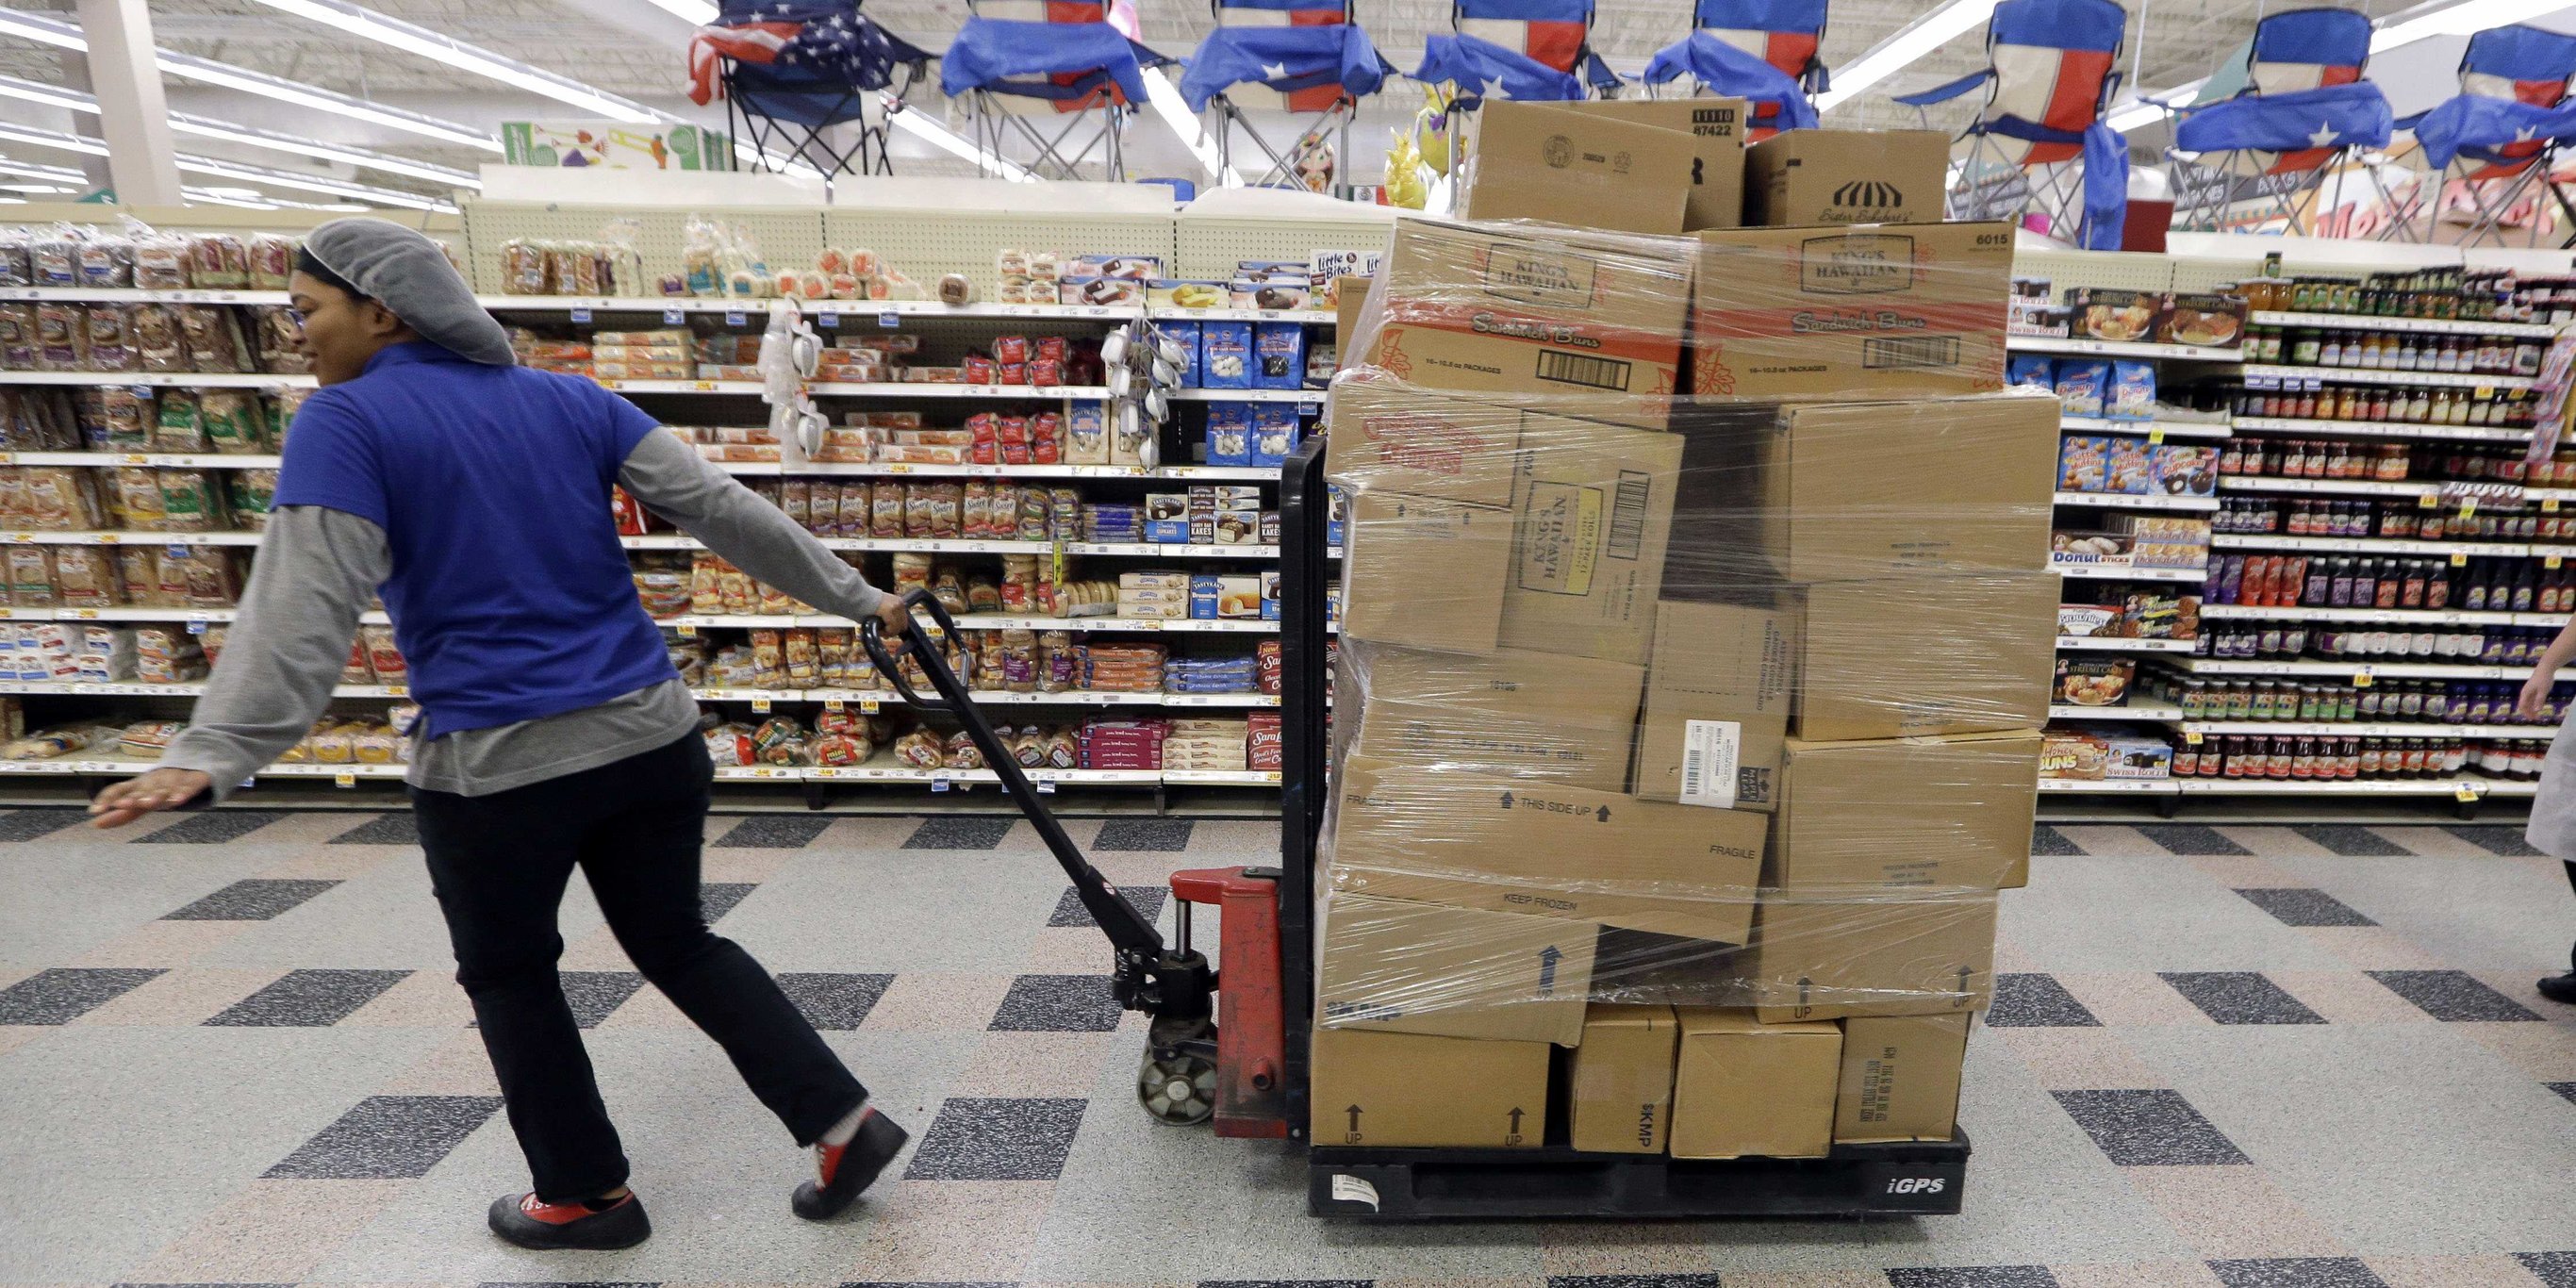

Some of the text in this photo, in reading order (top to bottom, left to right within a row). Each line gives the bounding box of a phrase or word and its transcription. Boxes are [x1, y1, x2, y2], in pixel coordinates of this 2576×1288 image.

[1976, 235, 2007, 244] 6015
[1318, 253, 1343, 272] Little
[1831, 251, 1886, 262] KING'S
[1326, 264, 1352, 280] Bites
[1515, 260, 1569, 278] KING'S
[1816, 264, 1898, 278] HAWAIIAN
[1500, 271, 1578, 290] HAWAIIAN
[1792, 311, 1926, 332] Sandwich Buns
[1471, 313, 1600, 348] Sandwich Buns
[1463, 363, 1501, 374] PACKAGES
[2163, 460, 2205, 476] Cupcakes
[1544, 495, 1567, 579] HAWAIIAN
[2054, 552, 2102, 563] Donut
[2058, 613, 2105, 626] Brownies
[1263, 644, 1280, 653] New!
[1263, 655, 1280, 669] Sar
[1252, 732, 1276, 746] Sara
[826, 750, 847, 759] mini
[2045, 745, 2074, 756] Honey
[2107, 768, 2168, 778] SWISS ROLLS
[1740, 771, 1751, 799] LEAF
[1749, 768, 1759, 801] MAPLE
[1521, 797, 1591, 816] THIS SIDE UP
[1709, 844, 1756, 859] FRAGILE
[1503, 893, 1577, 911] KEEP FROZEN
[1954, 995, 1969, 1008] UP
[1794, 1007, 1811, 1019] UP
[1346, 1133, 1362, 1146] UP
[1505, 1135, 1523, 1147] UP
[1887, 1178, 1946, 1195] iGPS
